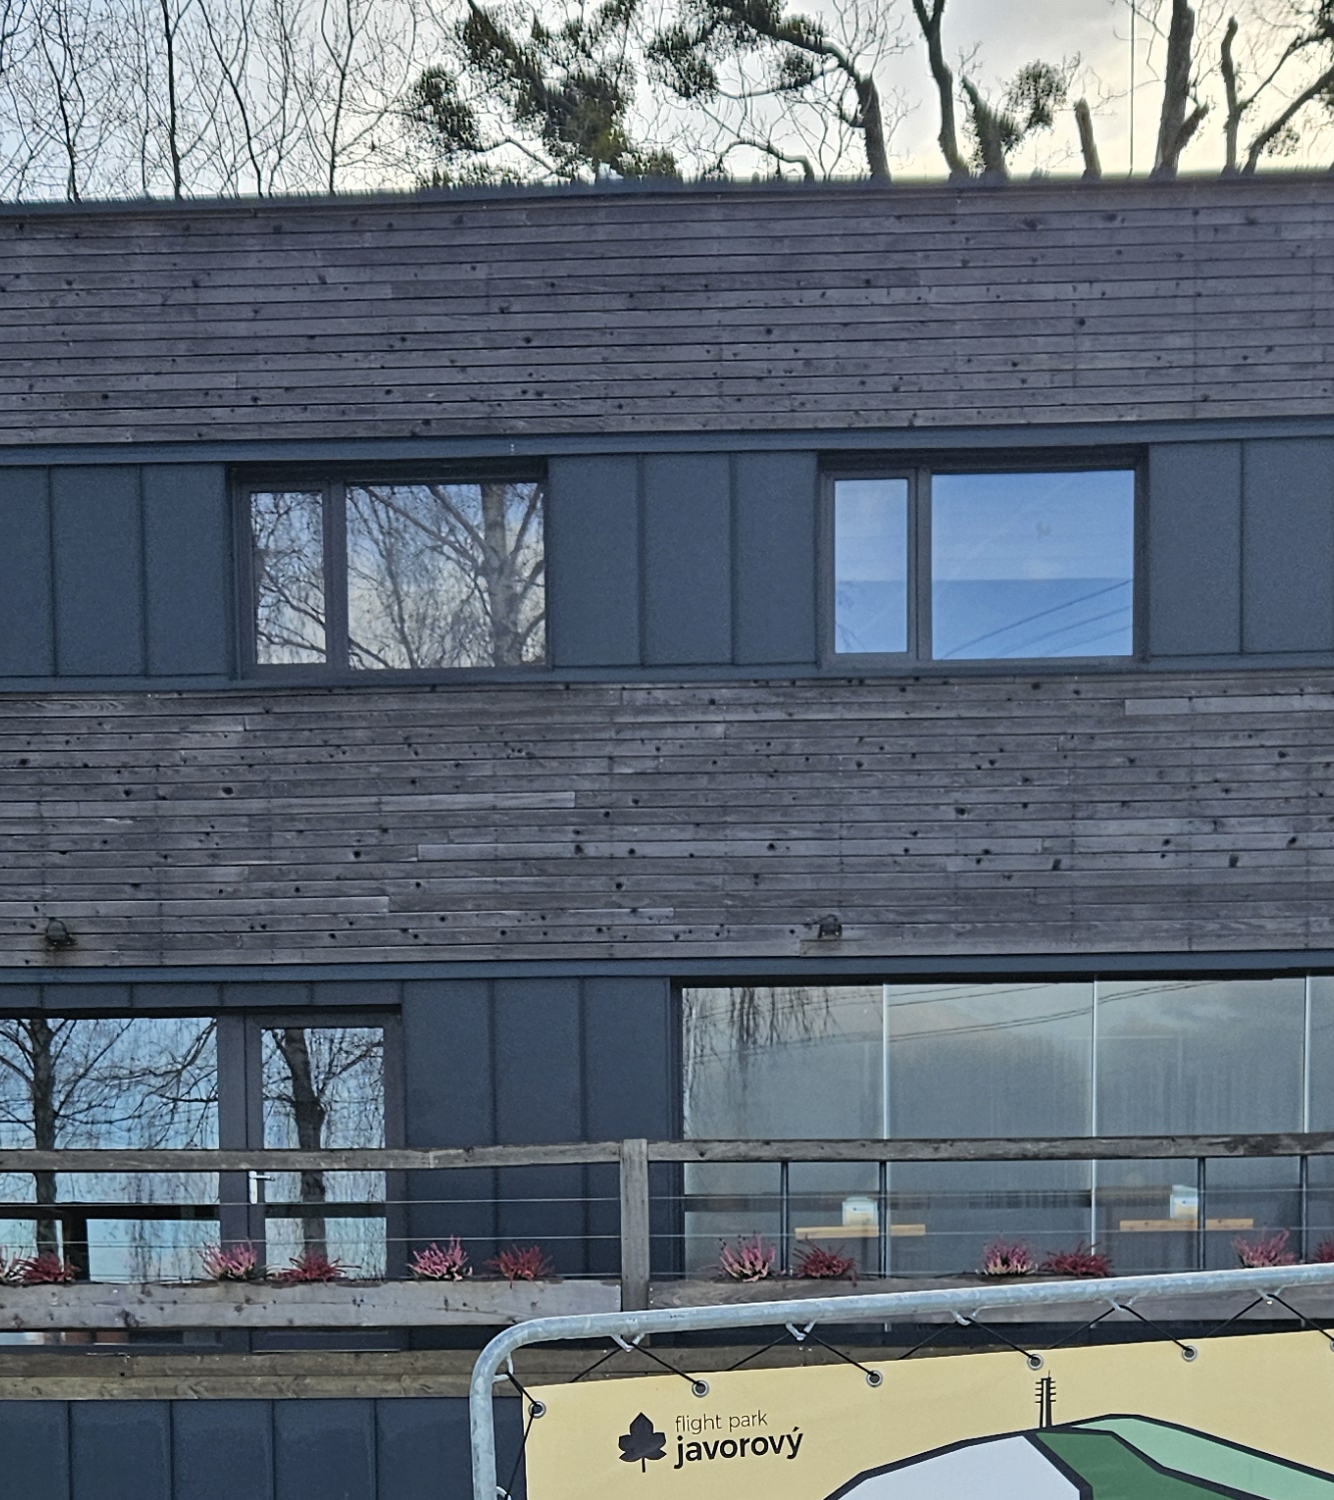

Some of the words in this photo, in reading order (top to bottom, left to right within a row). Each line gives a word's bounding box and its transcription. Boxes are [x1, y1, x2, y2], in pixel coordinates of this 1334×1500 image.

[675, 1413, 723, 1434] flight
[728, 1409, 769, 1432] park
[673, 1426, 804, 1470] javorový
